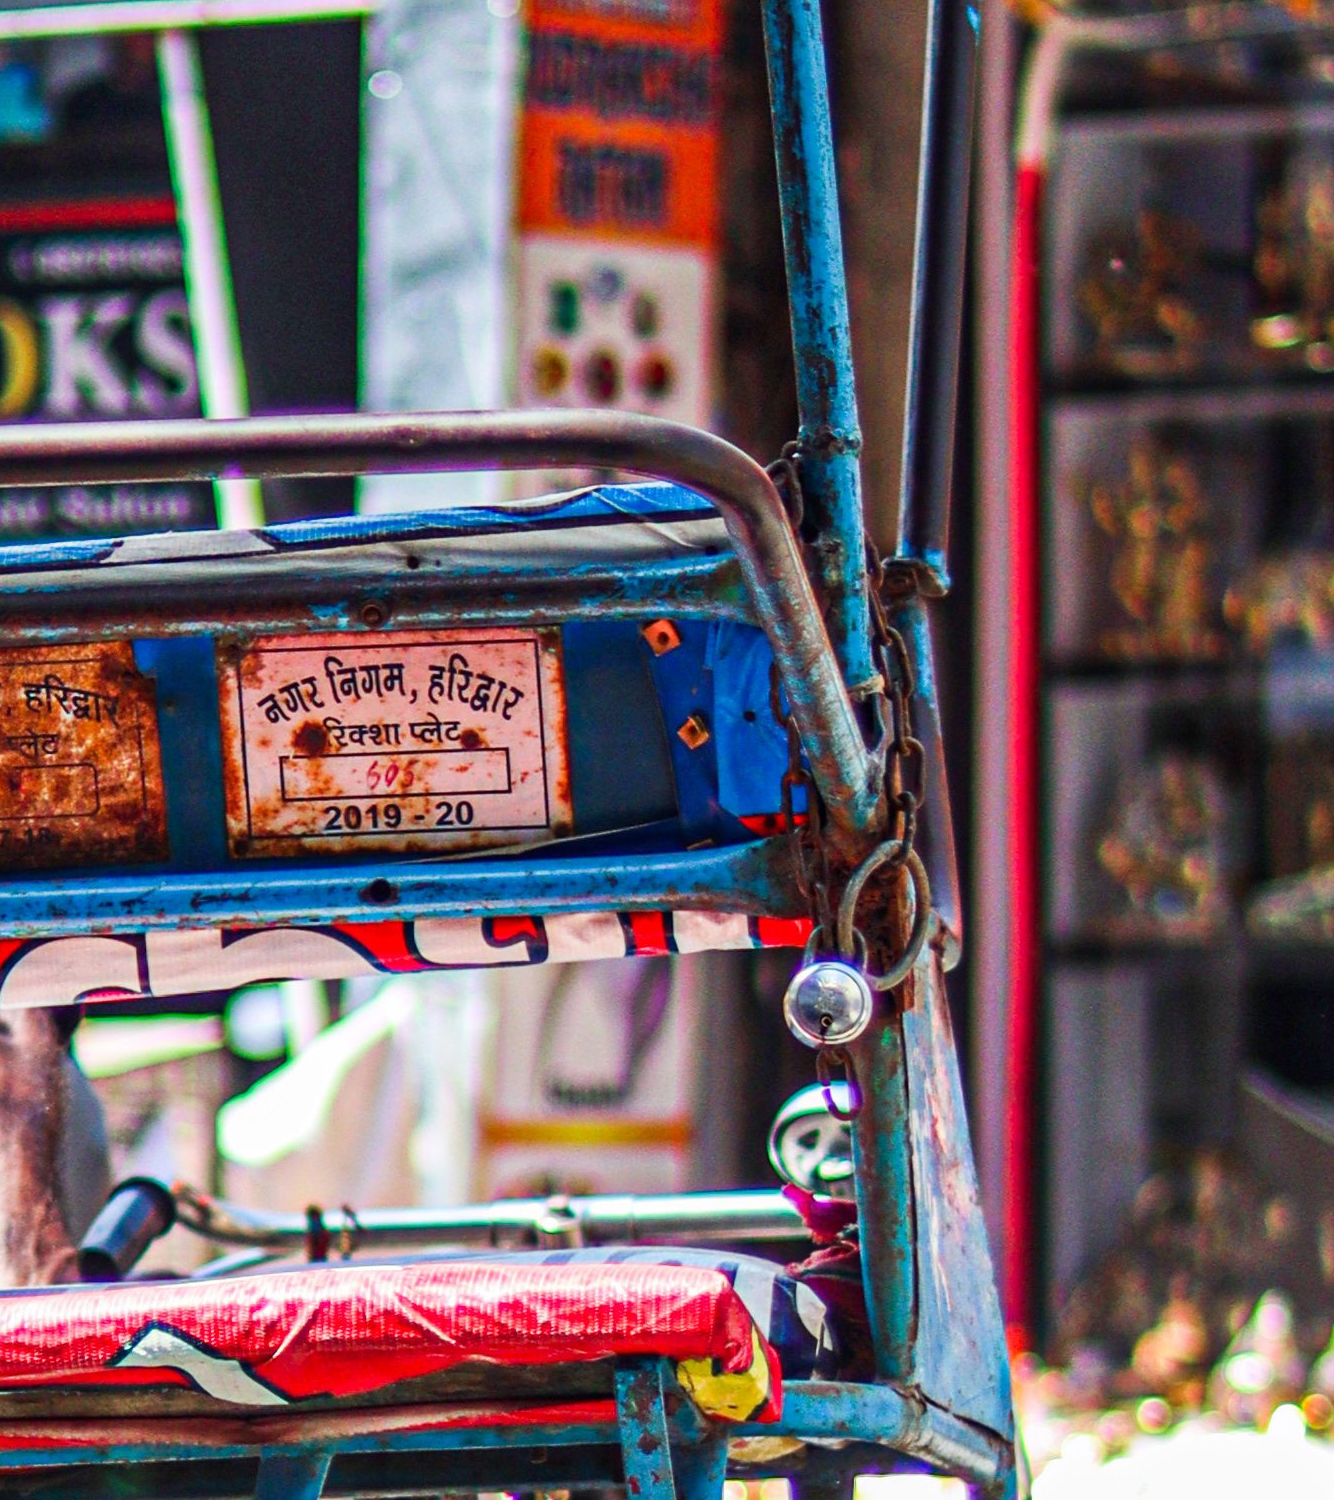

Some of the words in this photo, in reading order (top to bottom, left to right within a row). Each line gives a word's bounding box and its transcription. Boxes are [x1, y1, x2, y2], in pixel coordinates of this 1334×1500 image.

[257, 676, 327, 725] नगर
[427, 653, 525, 720] हरिद्वार
[323, 716, 402, 746] रिक्शा
[410, 712, 461, 744] प्लेट
[324, 803, 402, 831] 2019
[435, 801, 475, 828] 20
